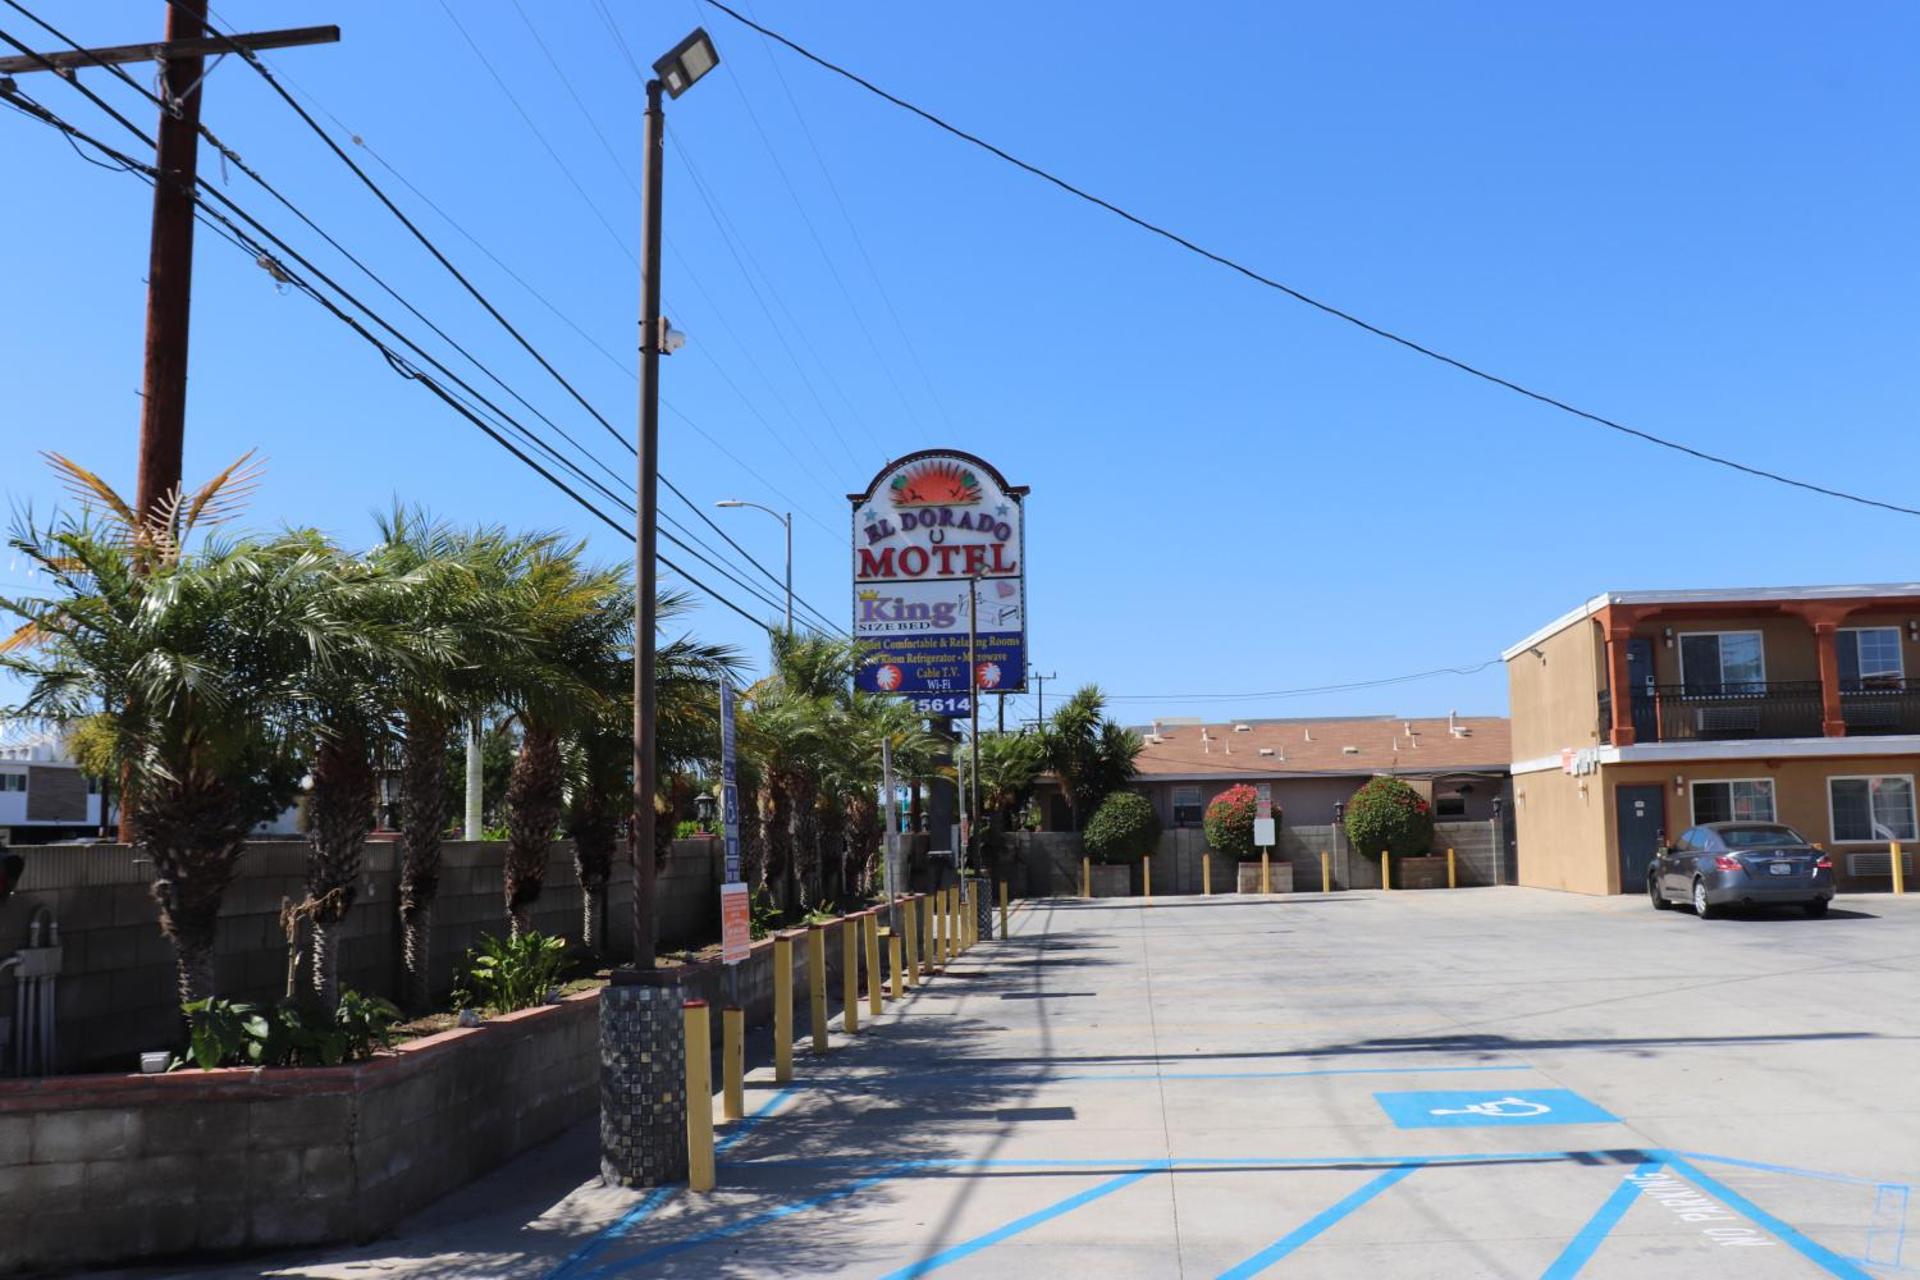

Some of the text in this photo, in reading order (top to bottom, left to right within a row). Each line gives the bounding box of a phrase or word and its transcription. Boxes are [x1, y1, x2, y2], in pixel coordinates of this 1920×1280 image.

[864, 508, 1012, 545] EL DORADO
[857, 543, 1017, 578] MOTEL
[859, 597, 957, 629] King
[859, 622, 931, 632] SIZE BED
[883, 636, 938, 649] Comfortable
[949, 636, 988, 650] Relang
[989, 635, 1020, 648] Rooms
[907, 652, 958, 666] Refrigerator
[962, 651, 1008, 663] Mrowave
[916, 667, 941, 679] Cable
